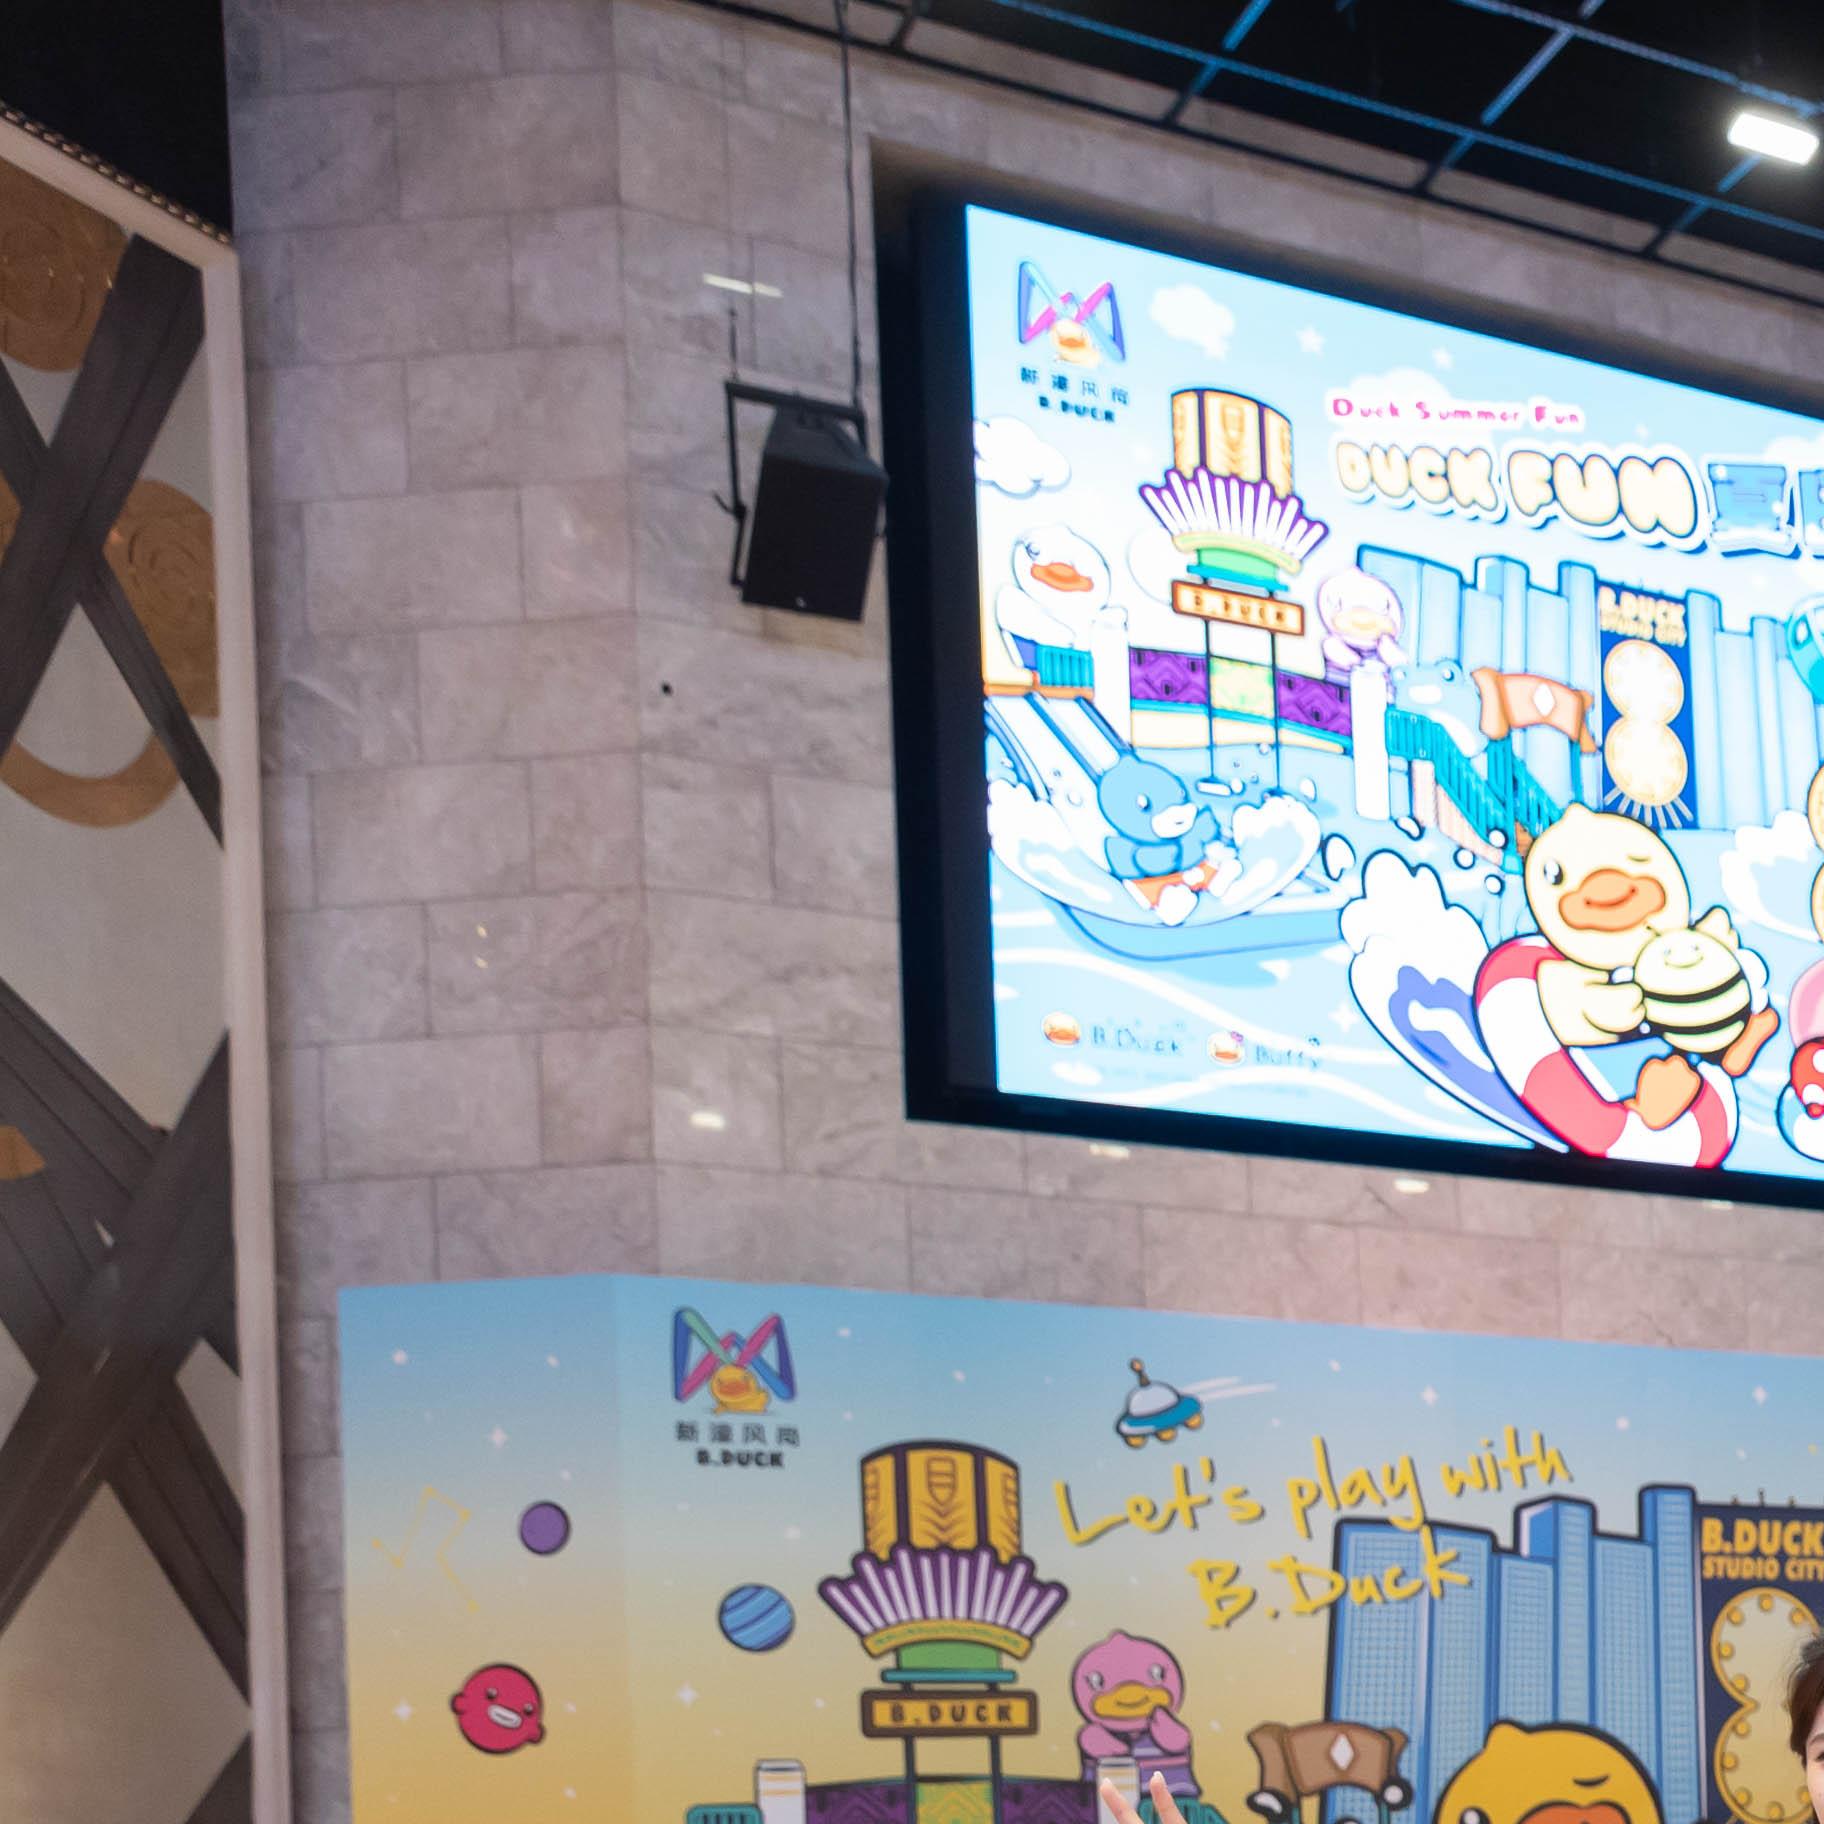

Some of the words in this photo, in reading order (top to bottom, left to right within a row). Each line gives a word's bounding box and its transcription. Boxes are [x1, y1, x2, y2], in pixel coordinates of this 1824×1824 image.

[1333, 398, 1400, 417] Duck
[1415, 401, 1519, 421] Summer
[1534, 405, 1579, 424] Fun
[1335, 442, 1498, 512] DUCK
[1507, 450, 1698, 539] FUN
[696, 1449, 783, 1468] B.DUCK
[1052, 1456, 1264, 1546] Let's
[1286, 1435, 1429, 1539] play
[1441, 1424, 1575, 1496] with
[1187, 1525, 1472, 1629] B.Duck
[1703, 1555, 1780, 1580] STUDIO
[891, 1703, 1011, 1725] B.DUCK
